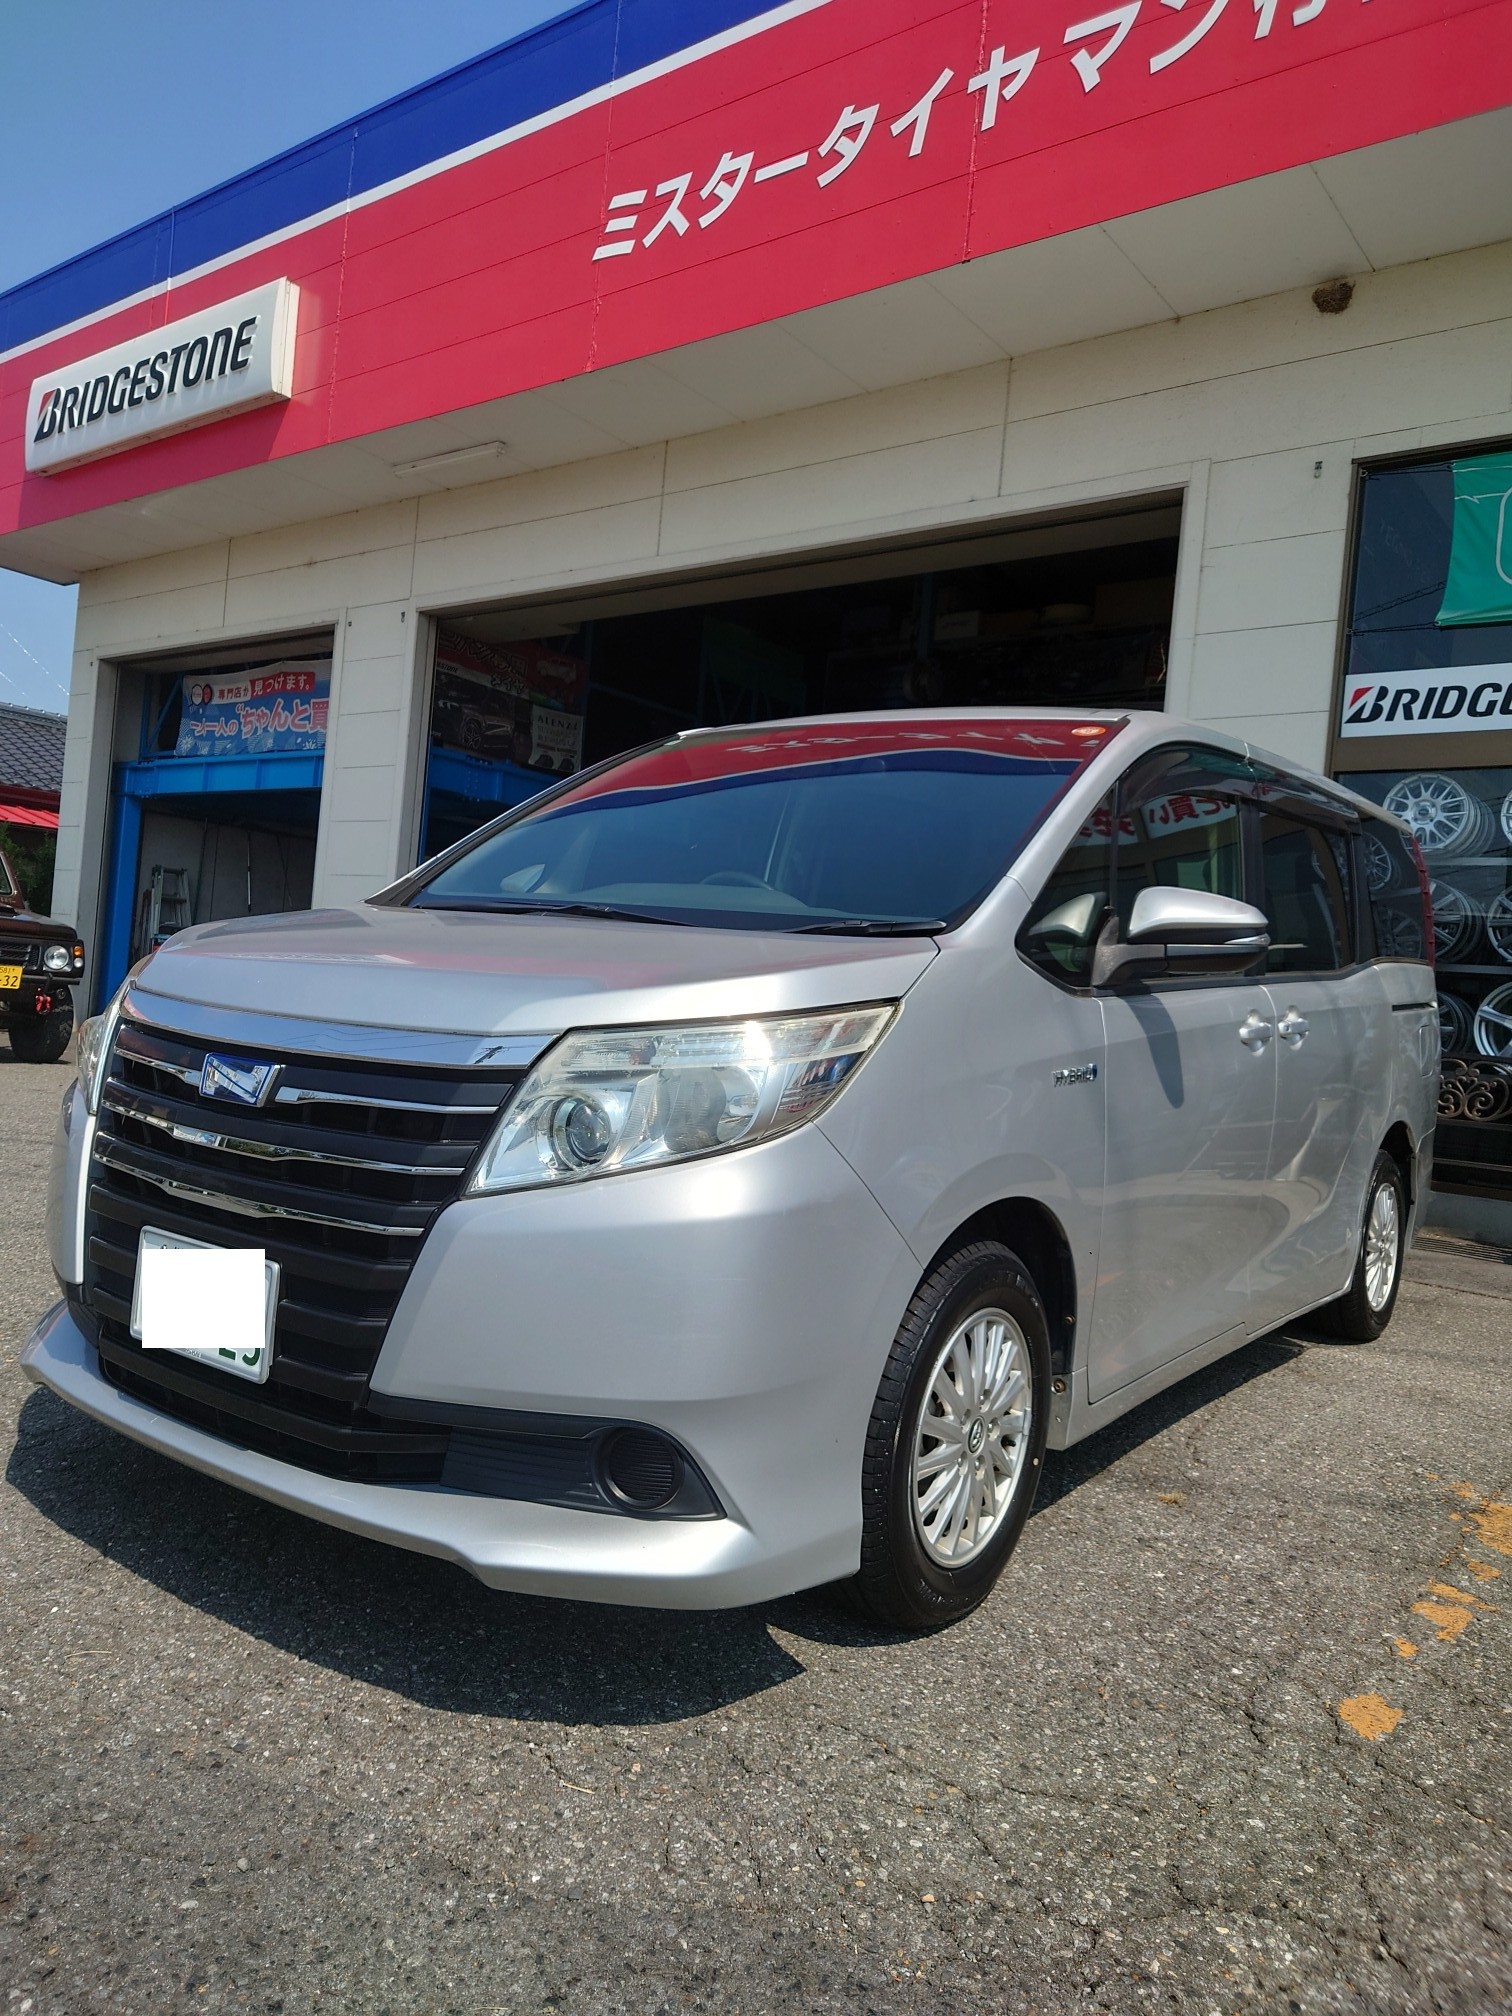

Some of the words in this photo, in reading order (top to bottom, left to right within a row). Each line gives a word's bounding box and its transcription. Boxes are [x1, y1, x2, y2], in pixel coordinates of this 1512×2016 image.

[592, 0, 1371, 260] ミスタータイヤマン
[34, 315, 258, 443] BRIDGESTONE
